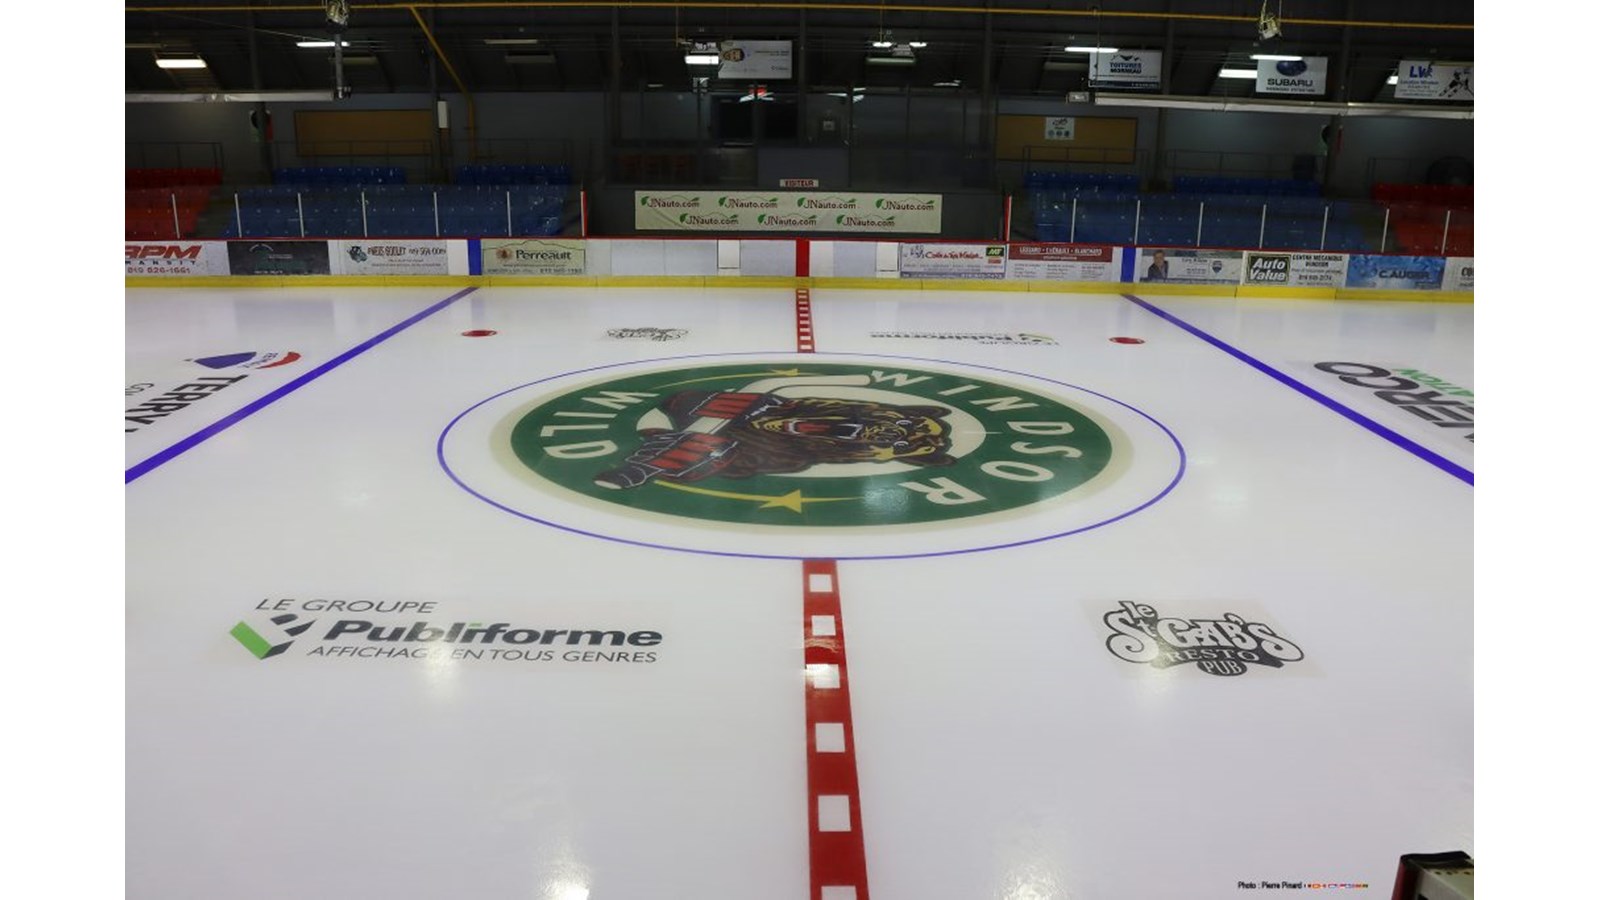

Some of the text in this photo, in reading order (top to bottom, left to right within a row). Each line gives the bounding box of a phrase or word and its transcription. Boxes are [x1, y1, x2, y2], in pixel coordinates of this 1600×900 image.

[1267, 78, 1313, 87] SUBARU
[647, 198, 699, 208] JNauto.com
[725, 198, 777, 209] JNauto.com
[803, 199, 856, 209] JNauto.com
[882, 199, 934, 211] JNauto.com
[686, 215, 738, 225] JNauto.com
[764, 215, 816, 226] JNauto.com
[842, 216, 895, 227] JNauto.com
[516, 249, 572, 260] Perreault
[1253, 258, 1286, 270] Auto
[1250, 268, 1286, 281] Value
[1313, 361, 1474, 444] ERCO
[539, 390, 661, 459] WILD
[870, 370, 1083, 505] WINDSOR
[255, 599, 438, 613] LE GROUPE
[1118, 600, 1157, 619] le
[323, 619, 663, 647] Publiforme
[307, 646, 657, 663] AFFICHAG EN TOUS GENRES
[1168, 650, 1260, 662] RESTO
[1205, 660, 1243, 675] PUB
